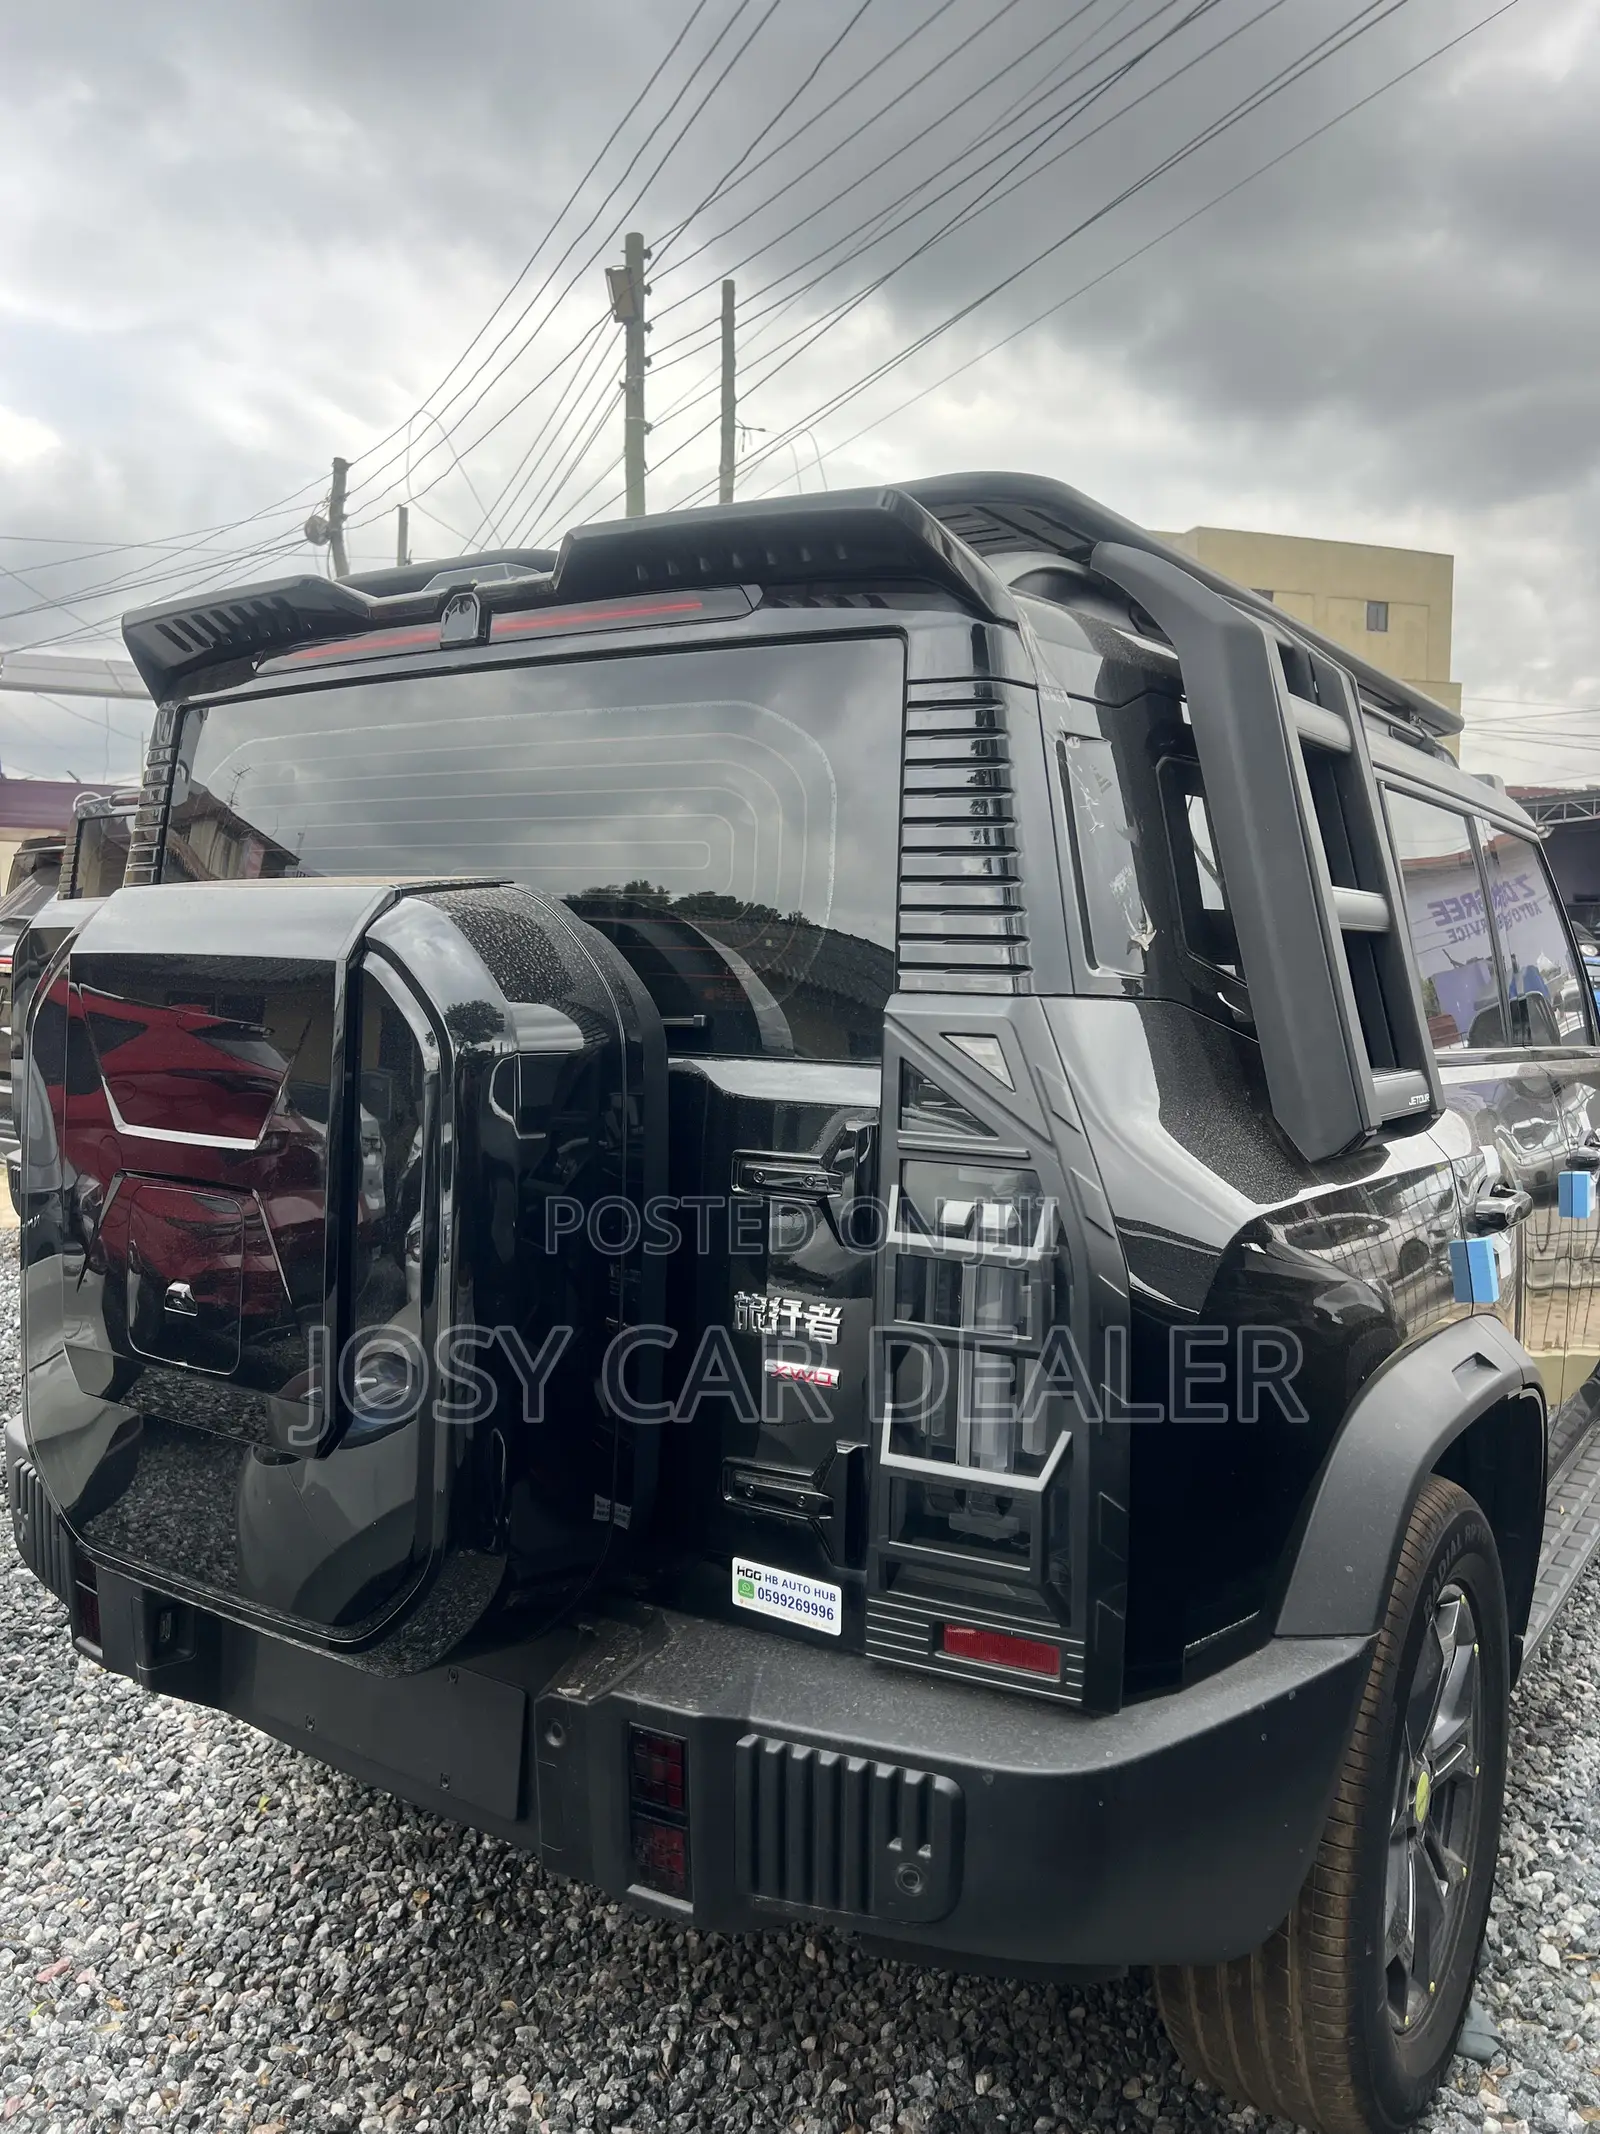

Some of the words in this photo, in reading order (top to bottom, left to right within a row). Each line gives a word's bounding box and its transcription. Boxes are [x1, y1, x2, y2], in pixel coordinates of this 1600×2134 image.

[1408, 1093, 1430, 1106] JETOUR
[733, 1291, 842, 1344] 旅行者
[770, 1364, 833, 1387] XWD
[764, 1573, 779, 1586] HB
[781, 1578, 811, 1595] AUTO
[814, 1587, 837, 1602] HUB
[757, 1586, 834, 1621] 0599269996
